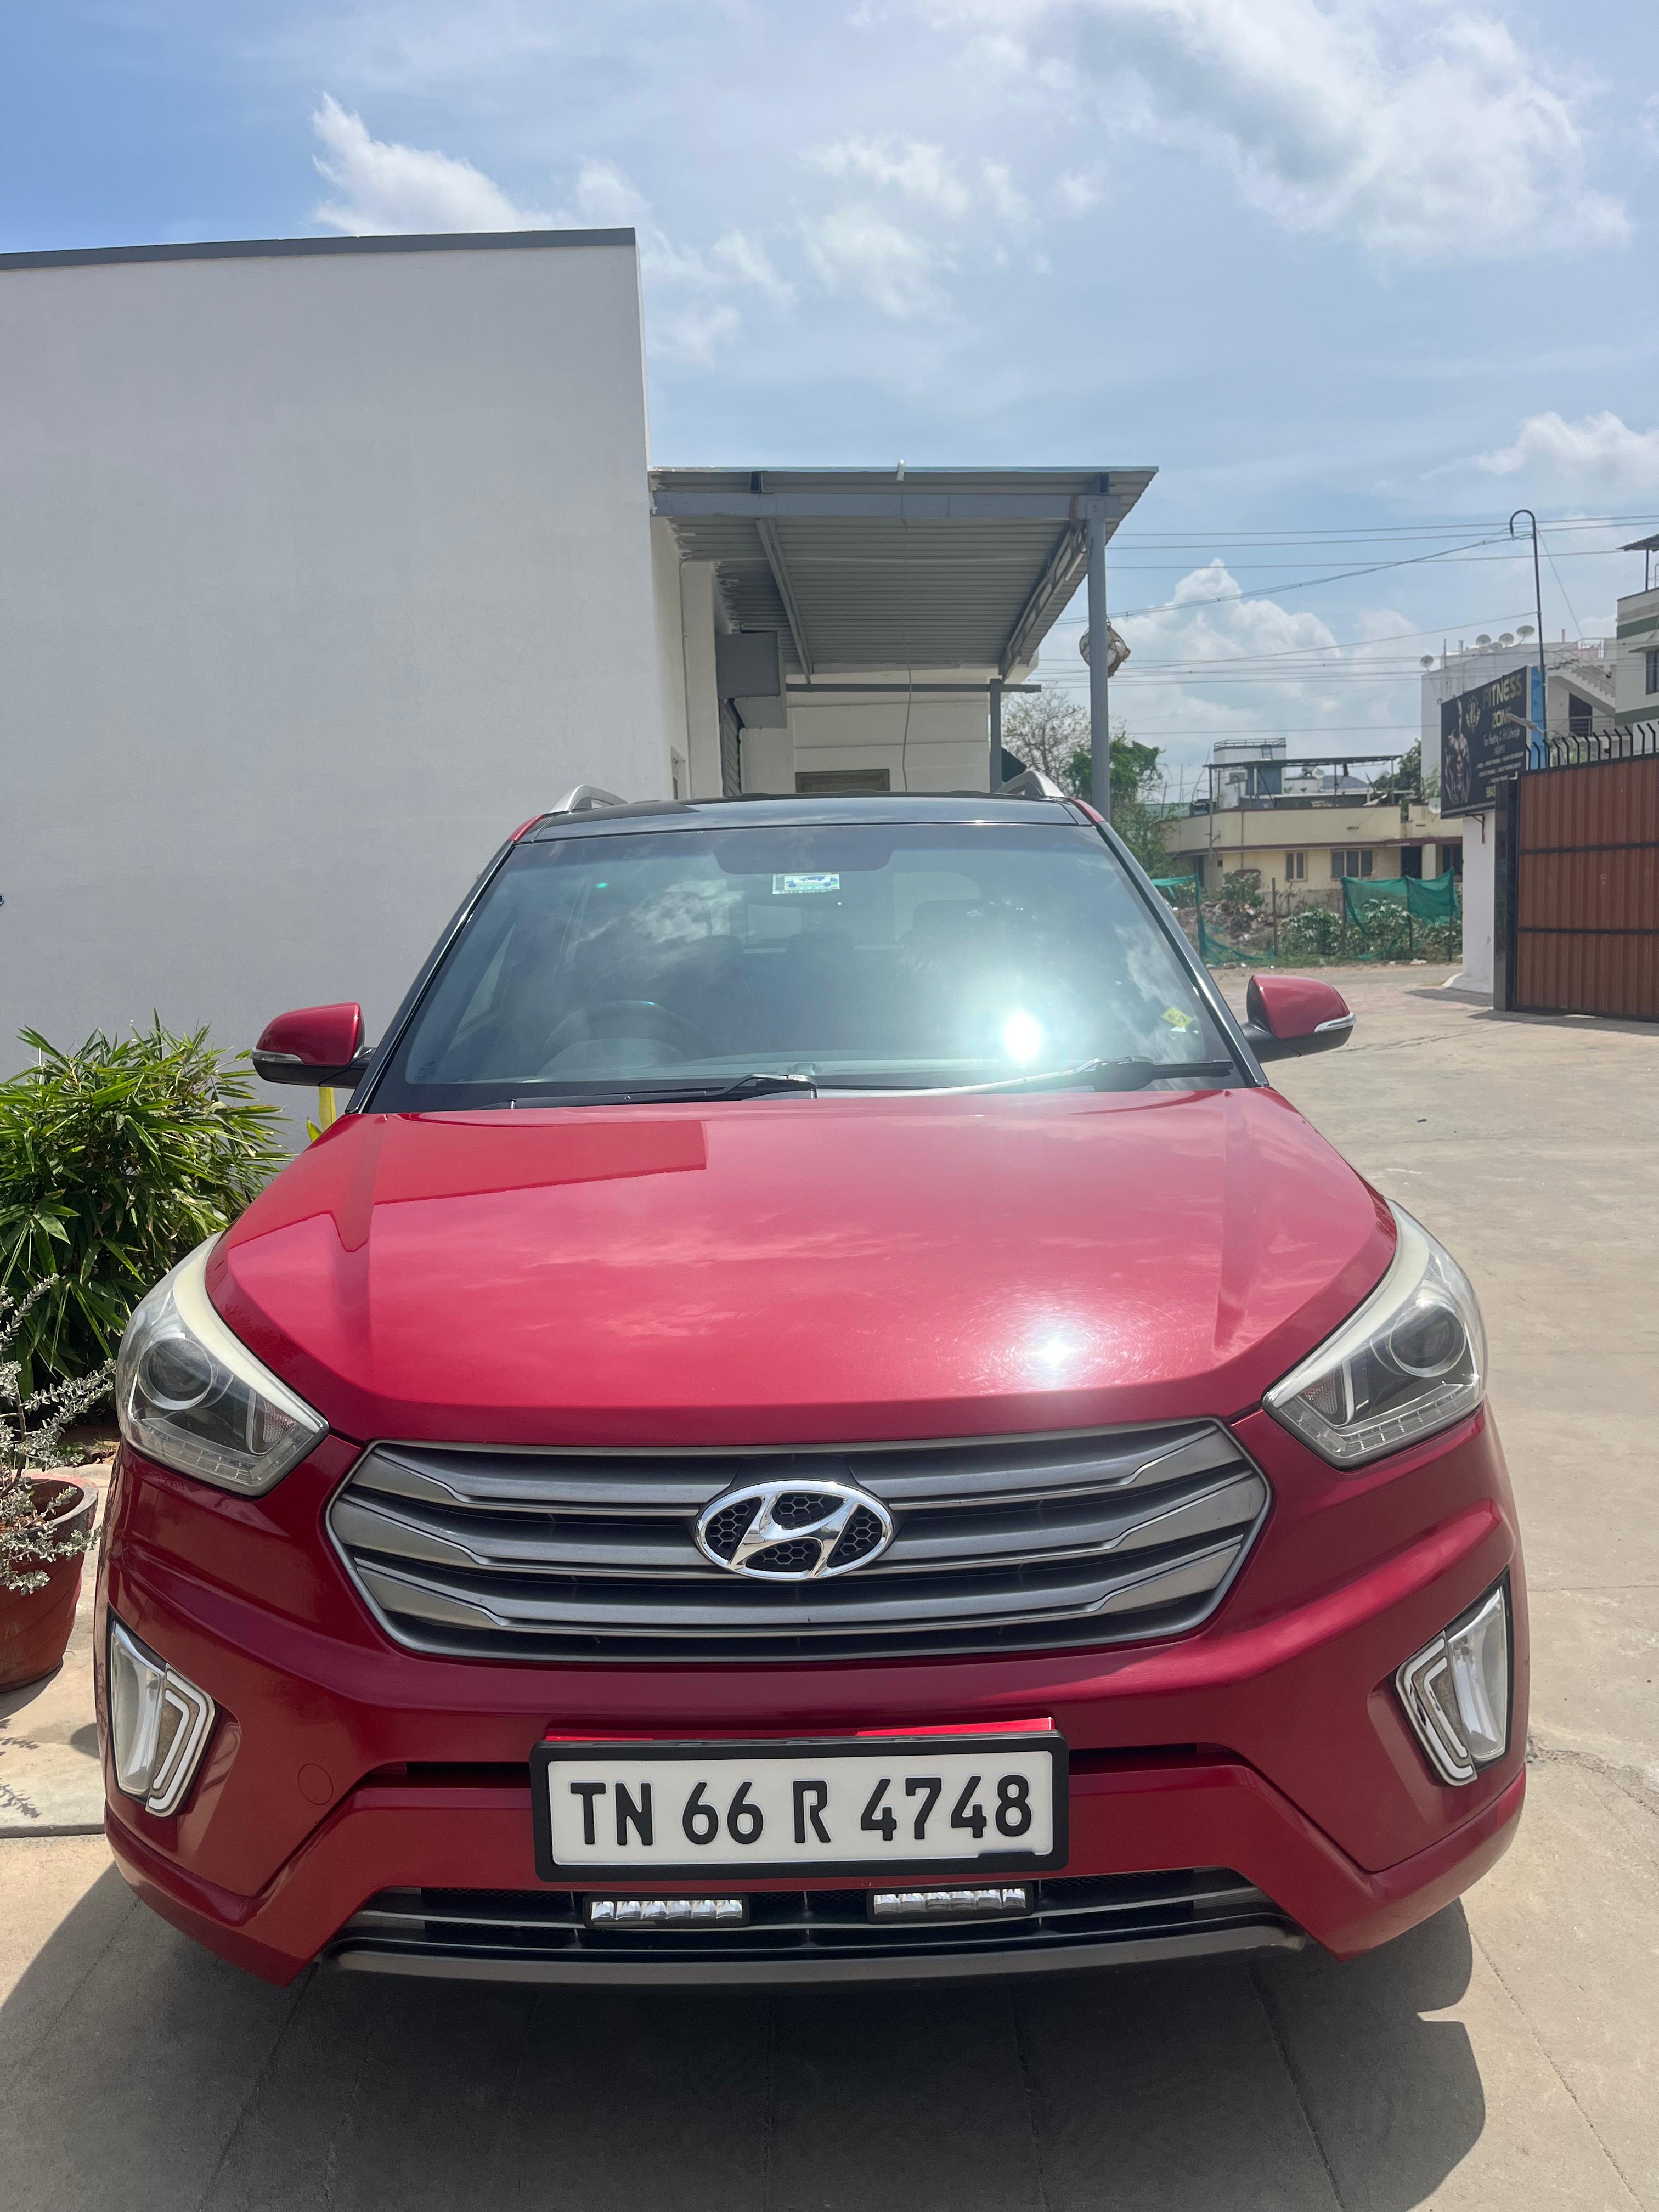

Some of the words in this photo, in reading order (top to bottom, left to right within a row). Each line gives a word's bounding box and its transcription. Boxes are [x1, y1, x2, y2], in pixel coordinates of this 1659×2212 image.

[1483, 673, 1522, 710] FITNESS
[569, 1782, 654, 1846] TN
[681, 1781, 764, 1846] 66
[792, 1780, 832, 1844] R
[860, 1774, 1032, 1841] 4748
